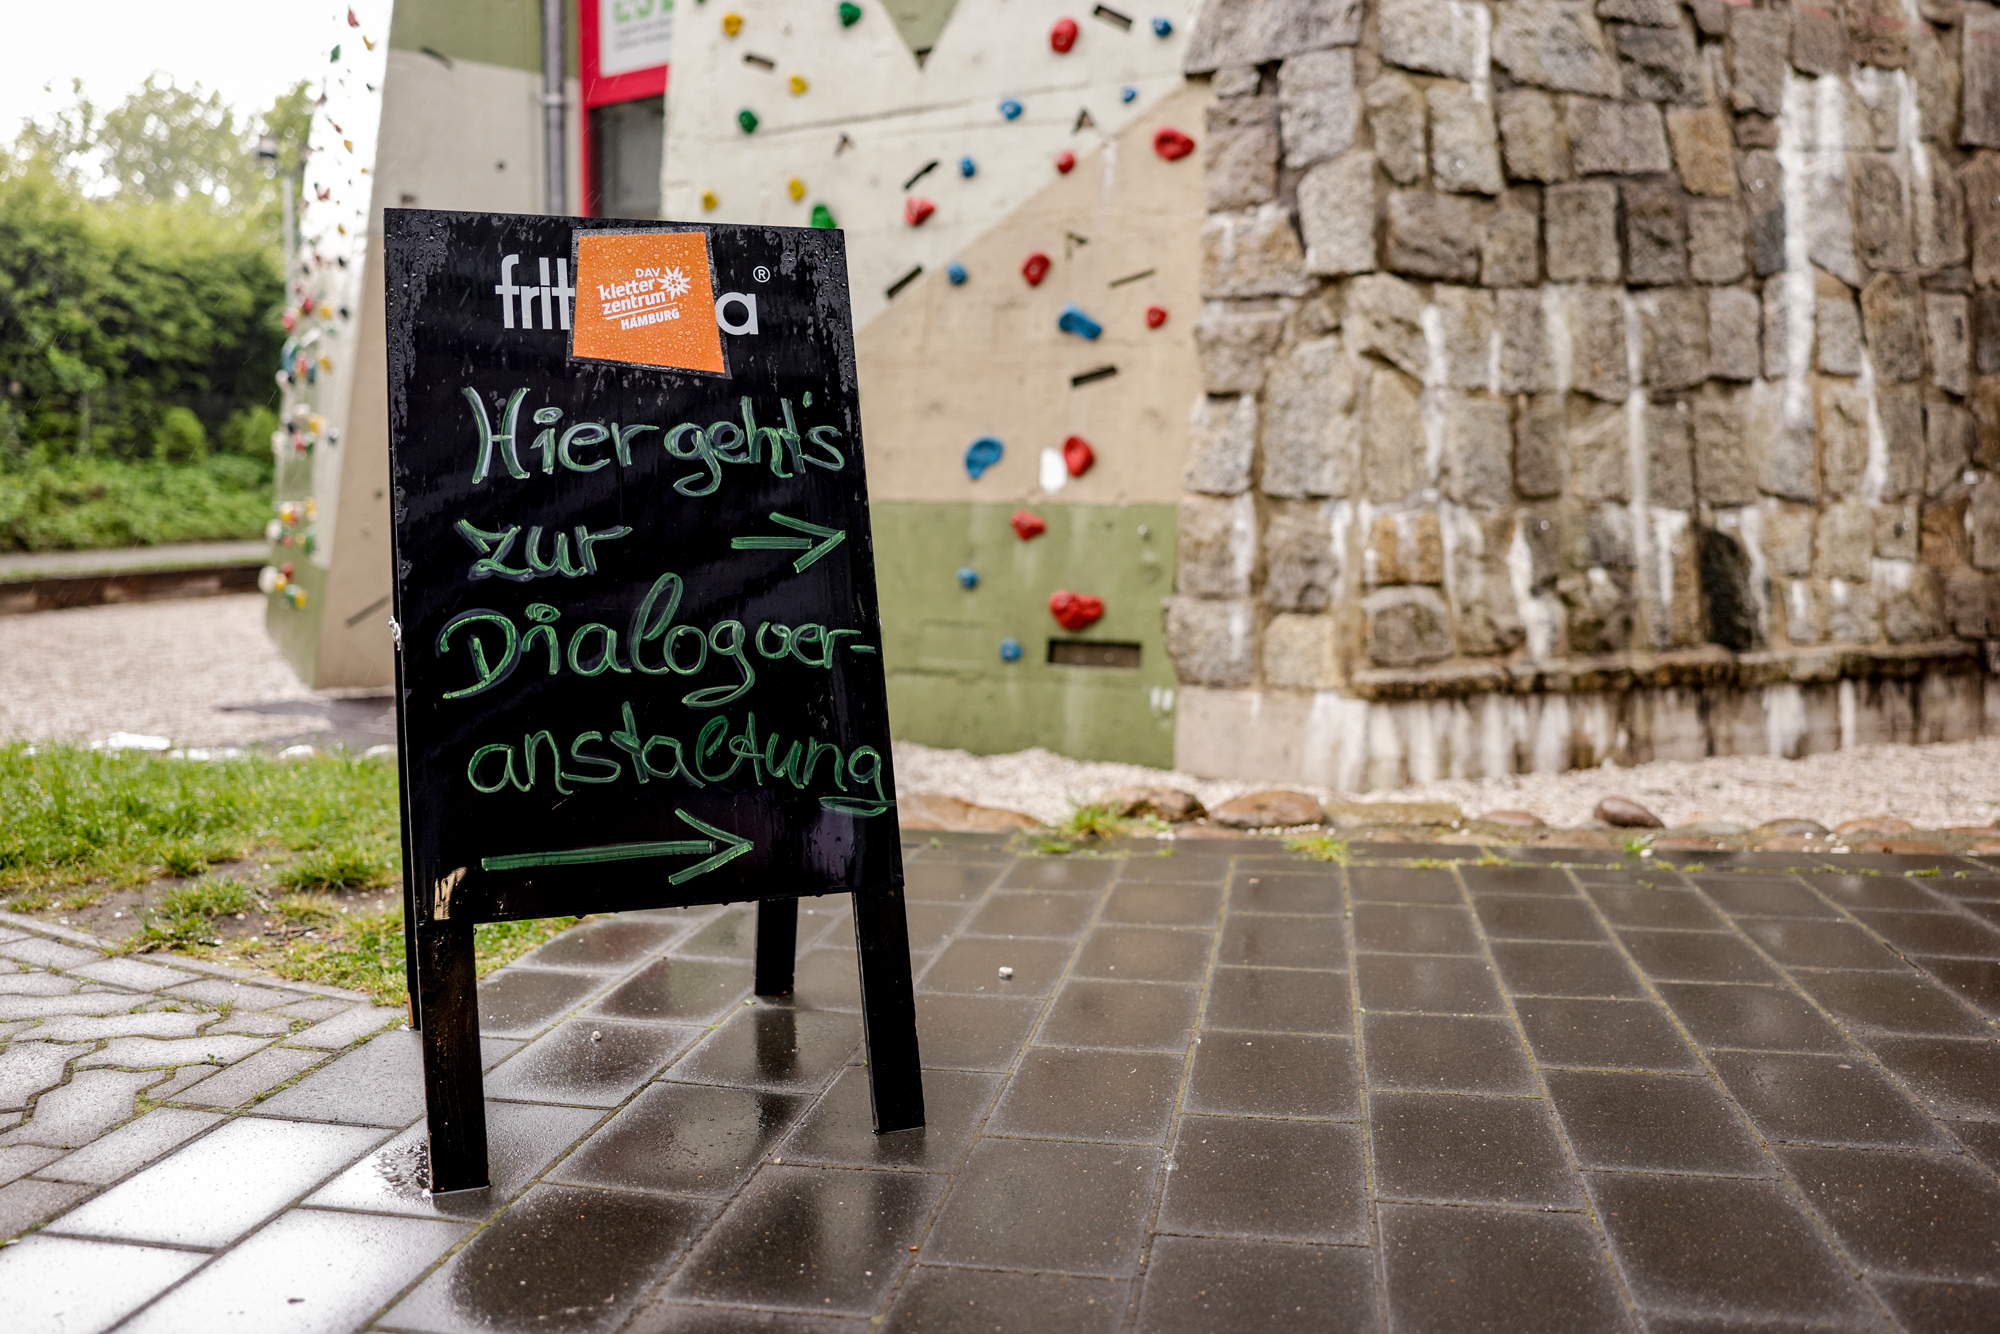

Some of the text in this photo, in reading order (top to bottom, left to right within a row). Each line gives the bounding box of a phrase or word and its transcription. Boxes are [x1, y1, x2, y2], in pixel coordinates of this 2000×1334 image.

[635, 267, 661, 278] DAV
[596, 278, 656, 301] kletter
[601, 291, 666, 315] zentrum
[620, 307, 680, 331] HAMBURG
[461, 386, 845, 496] Hier geht's
[455, 519, 633, 582] zur
[467, 701, 897, 817] anstaltung
